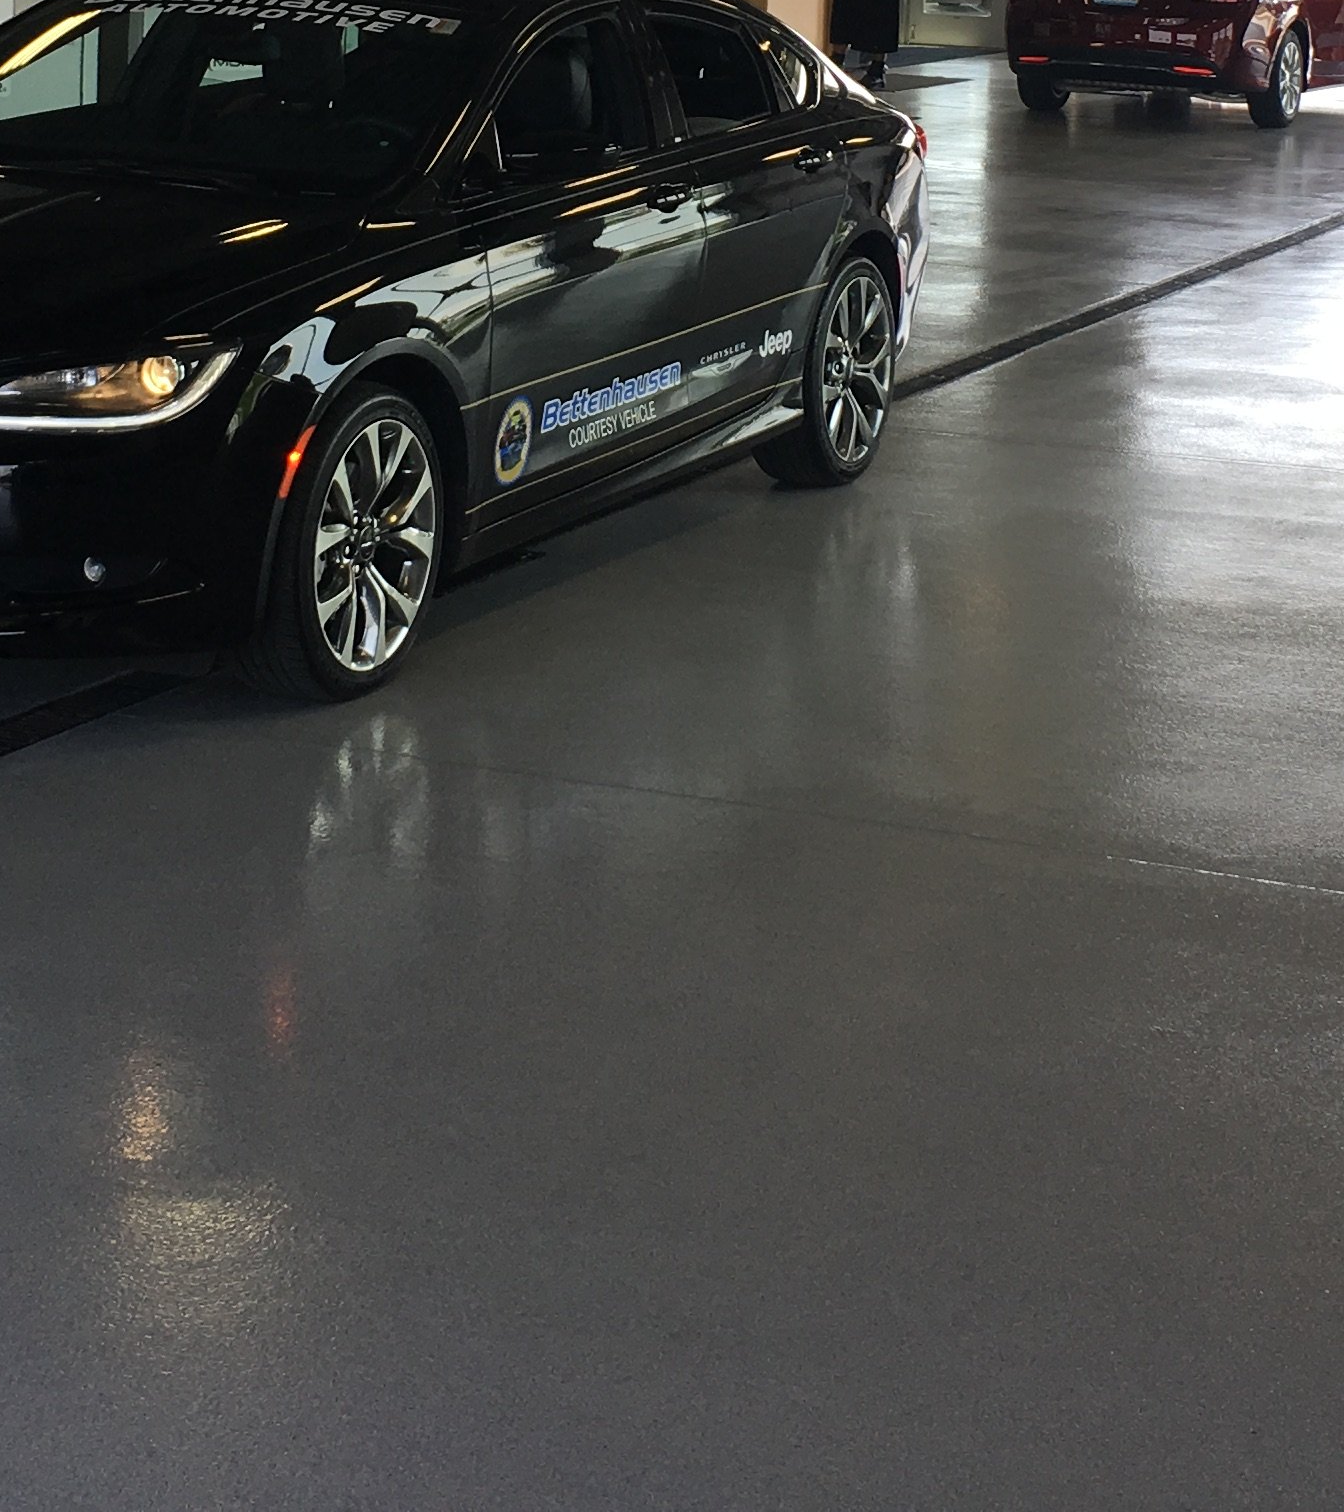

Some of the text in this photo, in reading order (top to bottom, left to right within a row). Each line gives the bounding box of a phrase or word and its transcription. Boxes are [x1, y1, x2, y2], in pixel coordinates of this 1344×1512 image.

[101, 2, 396, 34] AUTOMOTIVE
[700, 329, 793, 365] CHRYSLER Jeep
[541, 361, 682, 434] Bettenhausen
[569, 400, 657, 449] COURTESY VEHICLE
